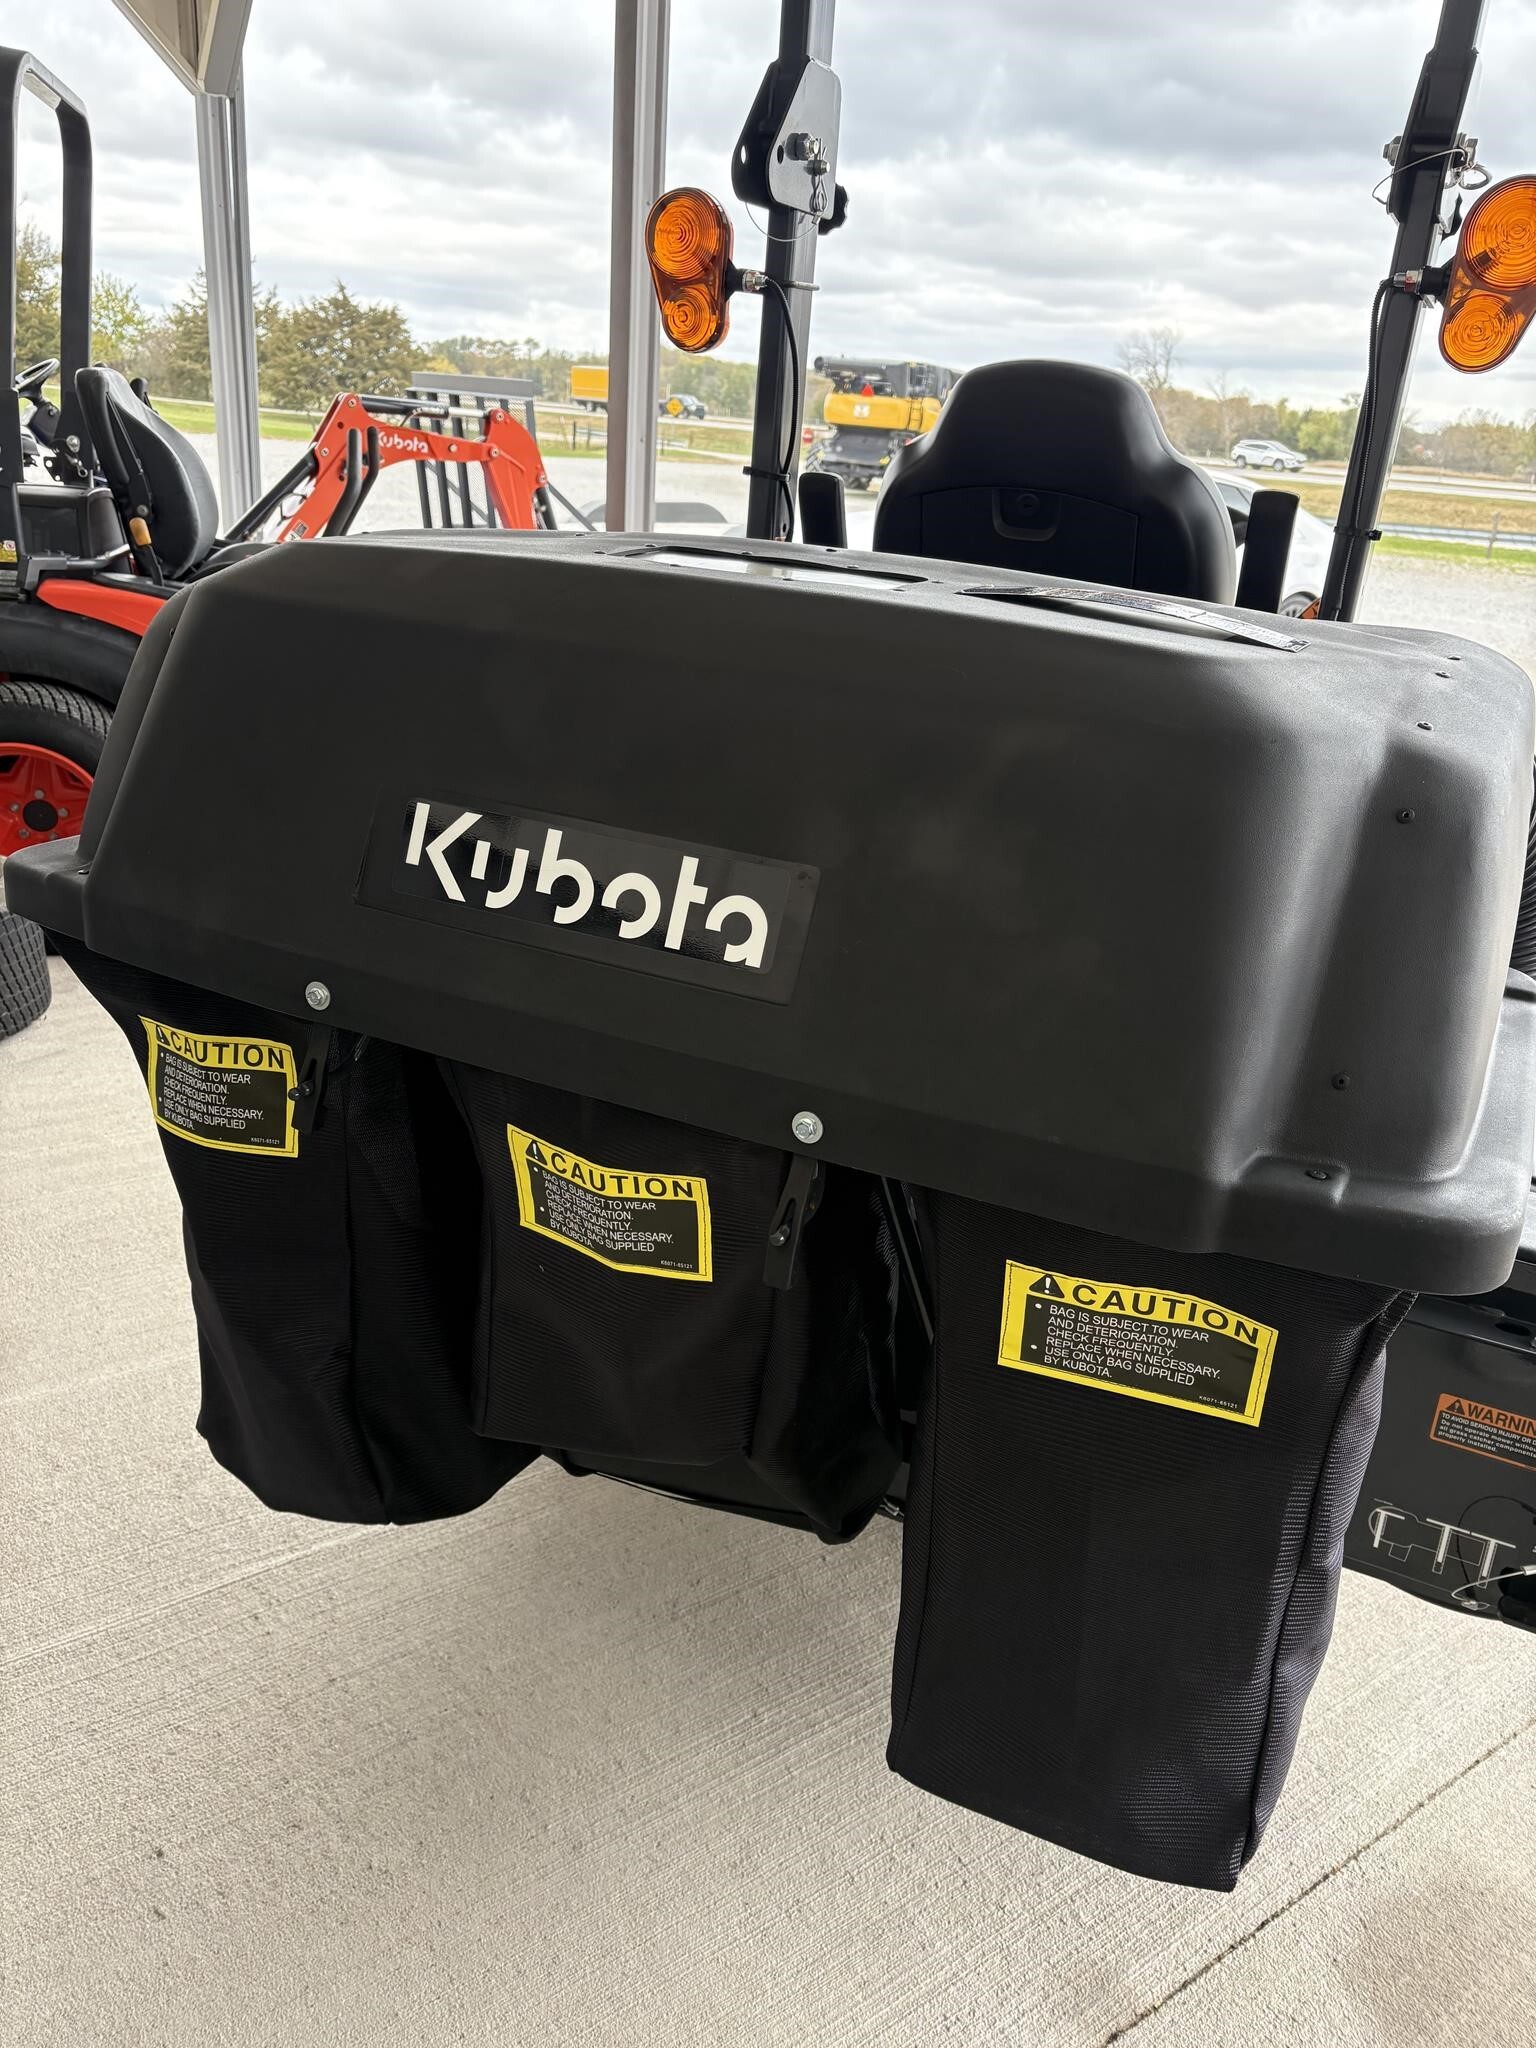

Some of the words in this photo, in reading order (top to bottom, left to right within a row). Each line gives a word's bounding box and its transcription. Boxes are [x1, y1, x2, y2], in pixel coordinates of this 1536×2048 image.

[405, 802, 768, 968] Kubota
[171, 1031, 285, 1069] CAUTION
[164, 1064, 176, 1077] AND
[176, 1069, 230, 1094] DETERIORATION.
[165, 1053, 176, 1066] BAG
[177, 1059, 182, 1069] IS
[182, 1061, 206, 1080] SUBJECT
[207, 1071, 220, 1082] TO
[222, 1073, 251, 1084] WEAR
[164, 1076, 181, 1092] CHECK
[182, 1084, 228, 1105] FREQUENTLY.
[164, 1087, 187, 1106] REPLACE
[187, 1098, 207, 1113] WHEN
[208, 1105, 264, 1120] NECESSARY.
[164, 1097, 174, 1111] USE
[175, 1103, 190, 1117] ONLY
[190, 1110, 203, 1123] BAG
[203, 1115, 246, 1130] SUPPLIED
[165, 1108, 171, 1119] BY
[171, 1112, 195, 1130] KUBOTA.
[543, 1170, 559, 1185] BAG
[560, 1179, 568, 1190] IS
[568, 1184, 605, 1207] SUBJECT
[607, 1200, 622, 1210] TO
[624, 1201, 656, 1210] WEAR
[551, 1152, 694, 1198] CAUTION
[545, 1180, 560, 1194] AND
[562, 1190, 634, 1220] DETERIORATION.
[545, 1190, 573, 1211] CHECK
[573, 1205, 632, 1230] FREQUENTLY.
[547, 1200, 582, 1226] REPLACE
[583, 1219, 608, 1238] WHEN
[610, 1231, 674, 1244] NECESSARY.
[549, 1209, 565, 1224] USE
[566, 1219, 586, 1234] ONLY
[587, 1230, 604, 1245] BAG
[605, 1239, 655, 1252] SUPPLIED
[550, 1219, 560, 1230] BY
[561, 1225, 594, 1248] KUBOTA.
[1050, 1305, 1075, 1319] BAG
[1078, 1312, 1090, 1323] IS
[1092, 1315, 1149, 1332] SUBJECT
[1152, 1324, 1168, 1335] TO
[1172, 1328, 1209, 1342] WEAR
[1072, 1284, 1259, 1345] CAUTION
[1047, 1326, 1089, 1343] CHECK
[1092, 1336, 1174, 1357] FREQUENTLY.
[1048, 1316, 1074, 1330] AND
[1077, 1323, 1179, 1348] DETERIORATION.
[1044, 1355, 1060, 1365] BY
[1062, 1359, 1112, 1378] KUBOTA.
[1045, 1346, 1069, 1358] USE
[1072, 1351, 1104, 1364] ONLY
[1106, 1357, 1132, 1370] BAG
[1135, 1362, 1195, 1386] SUPPLIED
[1046, 1336, 1101, 1354] REPLACE
[1105, 1347, 1142, 1361] WHEN
[1144, 1354, 1220, 1379] NECESSARY.
[1438, 1431, 1466, 1444] properly
[1449, 1429, 1468, 1438] grass
[1469, 1434, 1495, 1445] catcher
[1451, 1415, 1470, 1425] AVOID
[1470, 1421, 1497, 1434] SERIOUS
[1498, 1430, 1520, 1441] INJURY
[1521, 1436, 1531, 1444] OR
[1464, 1427, 1489, 1438] operate
[1491, 1435, 1514, 1445] mower
